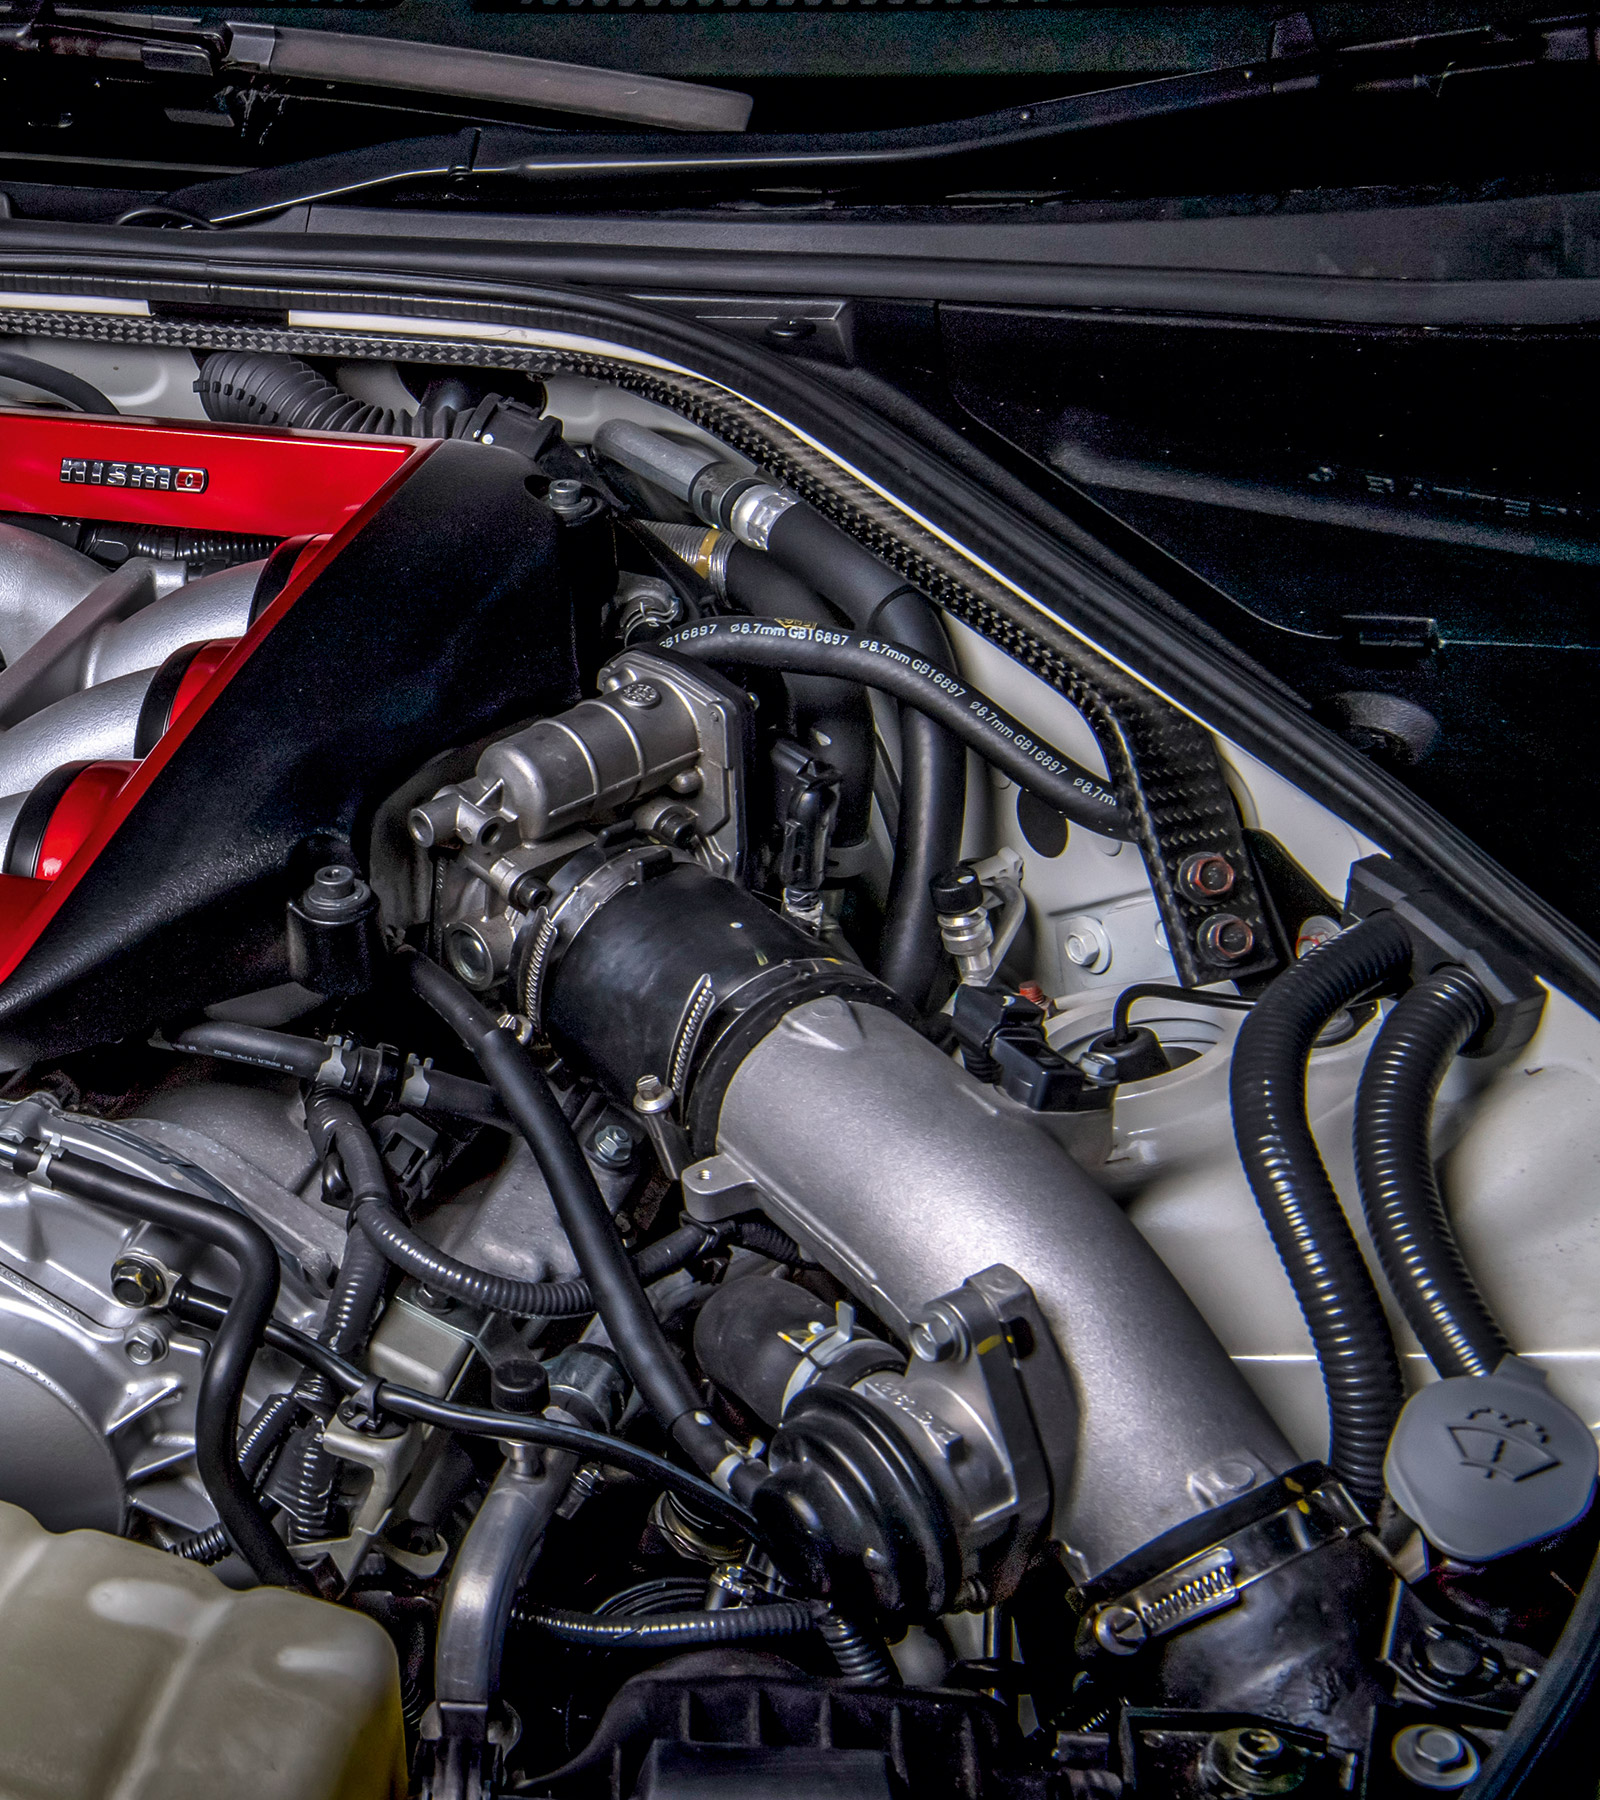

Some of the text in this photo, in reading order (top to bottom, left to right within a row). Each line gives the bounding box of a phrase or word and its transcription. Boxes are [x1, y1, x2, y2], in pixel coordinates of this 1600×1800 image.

[788, 626, 849, 646] GB16897
[911, 658, 966, 699] GB16897
[1013, 734, 1069, 776] GB16897
